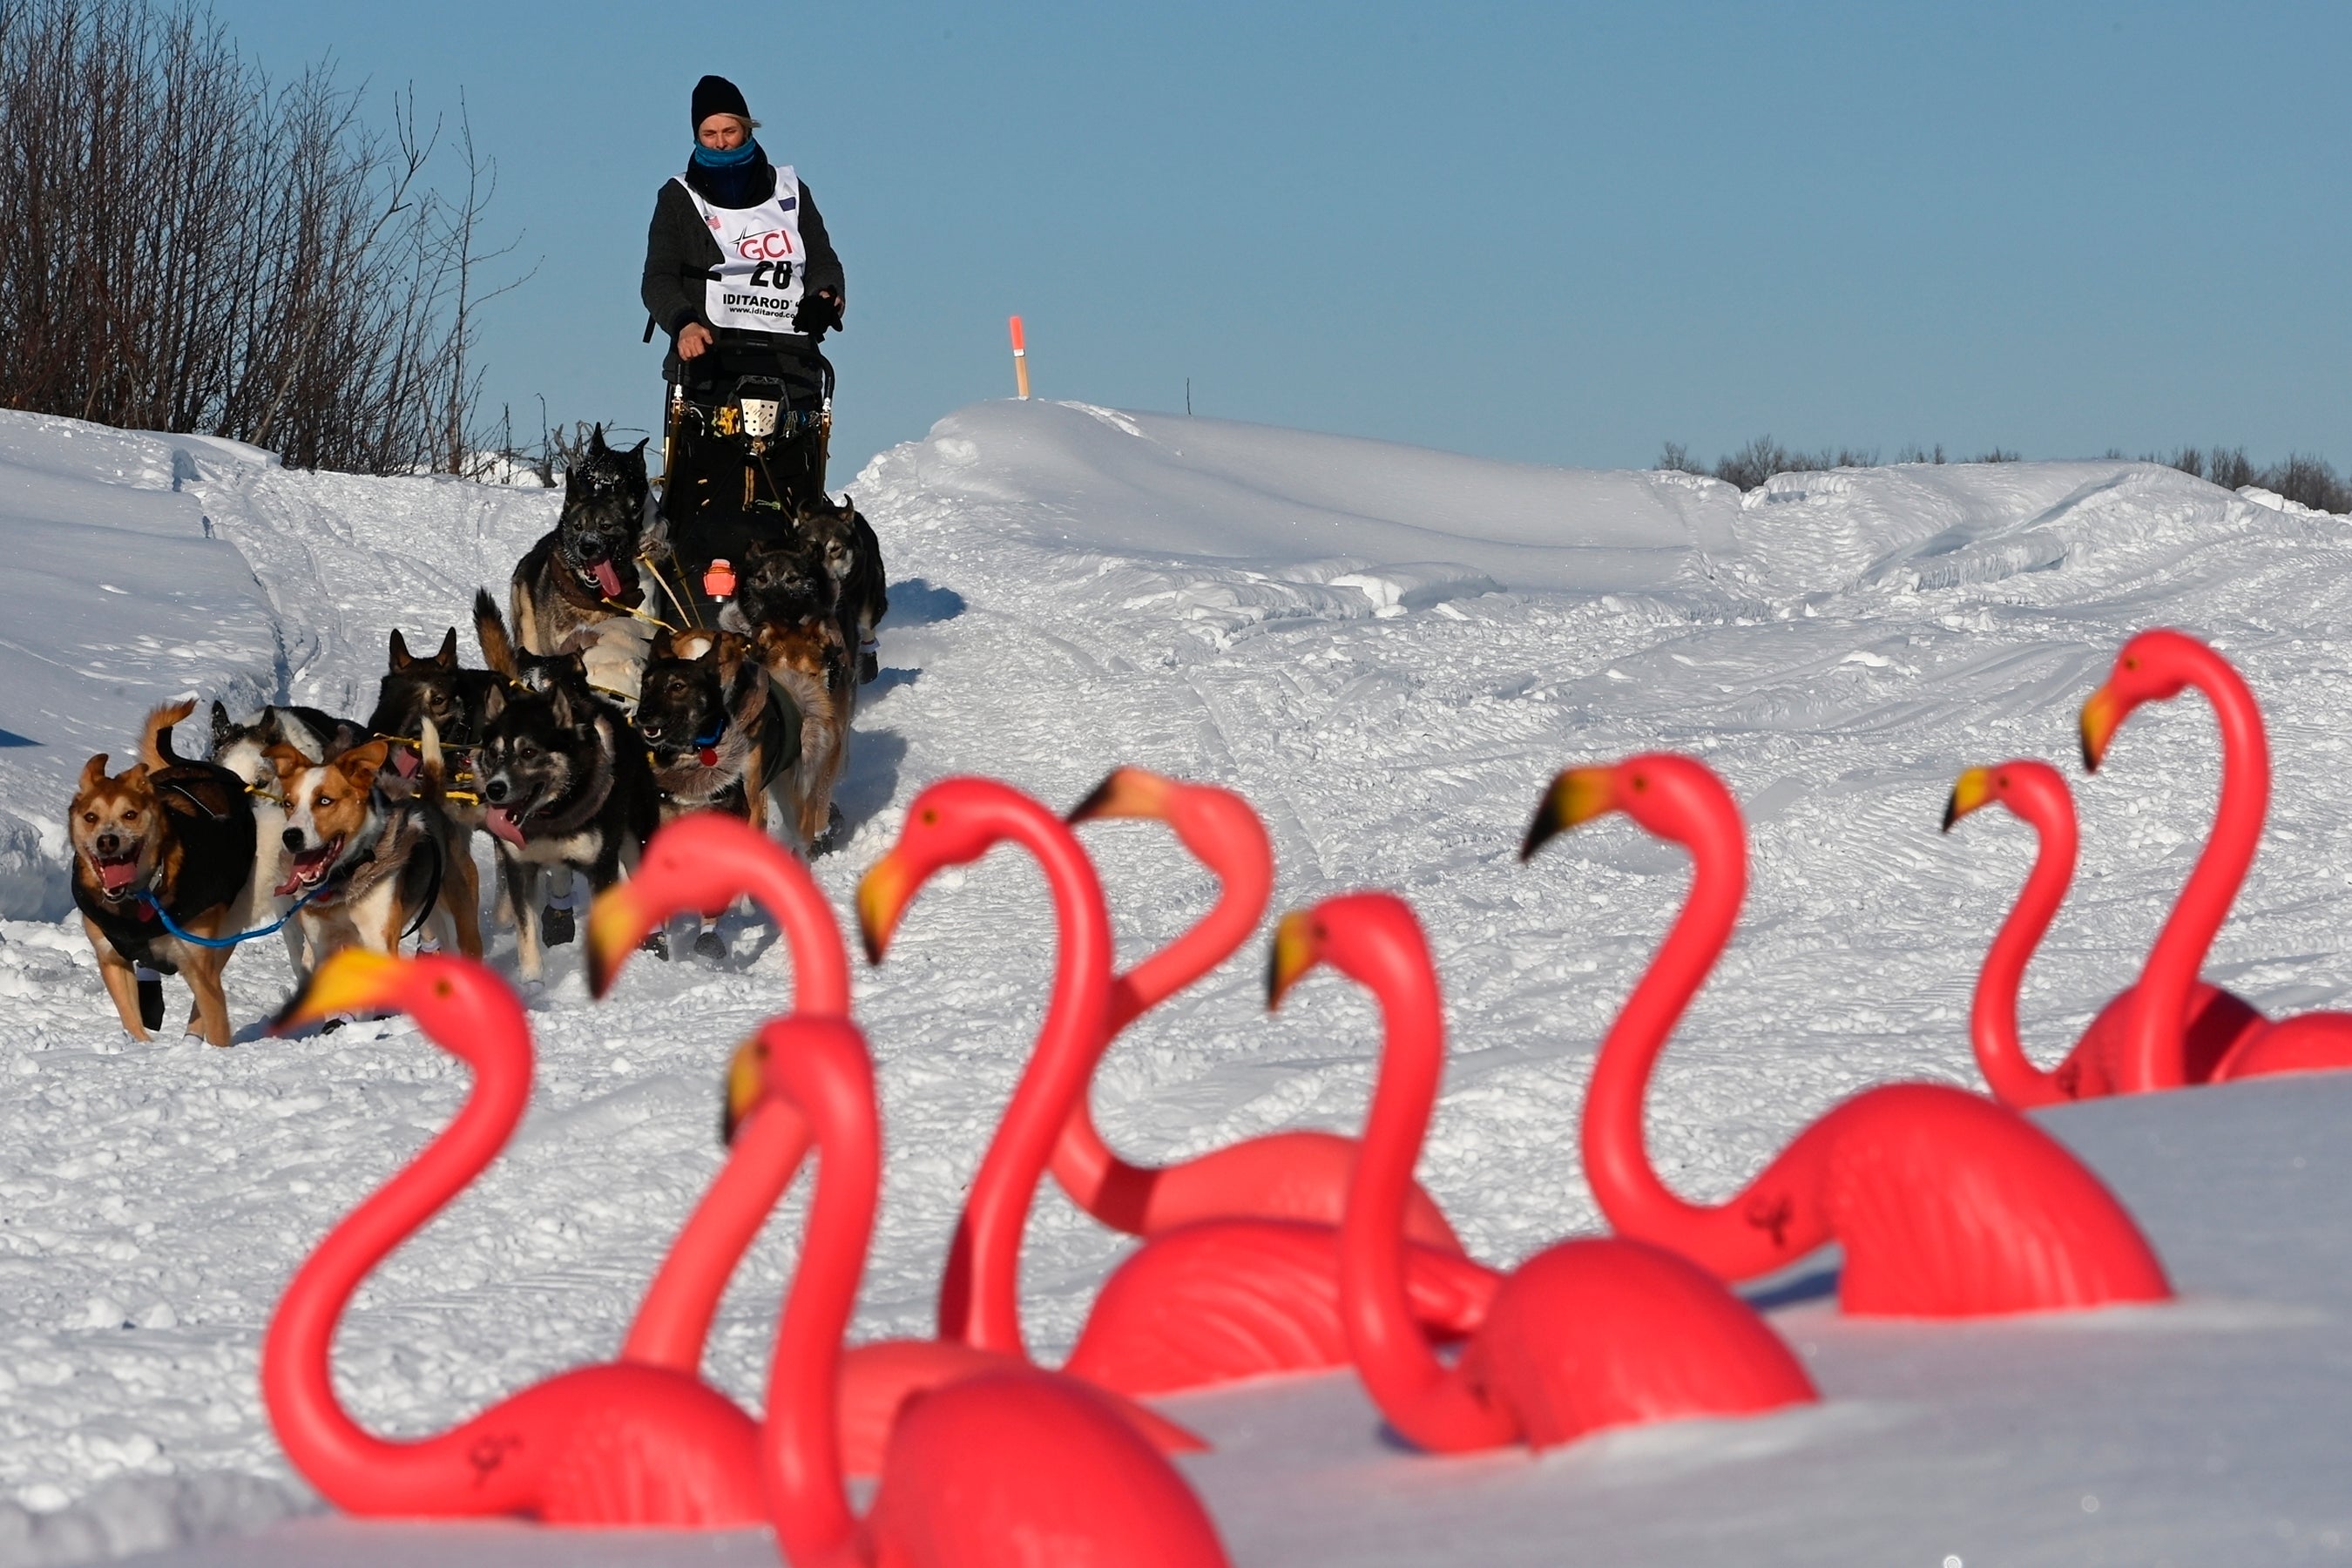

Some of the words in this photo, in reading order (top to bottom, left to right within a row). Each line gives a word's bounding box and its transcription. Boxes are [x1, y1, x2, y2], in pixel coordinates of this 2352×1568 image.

[740, 230, 793, 260] GCI
[749, 260, 793, 290] 28
[722, 294, 790, 310] IDITAROD
[729, 307, 795, 319] www.iditarod.co
